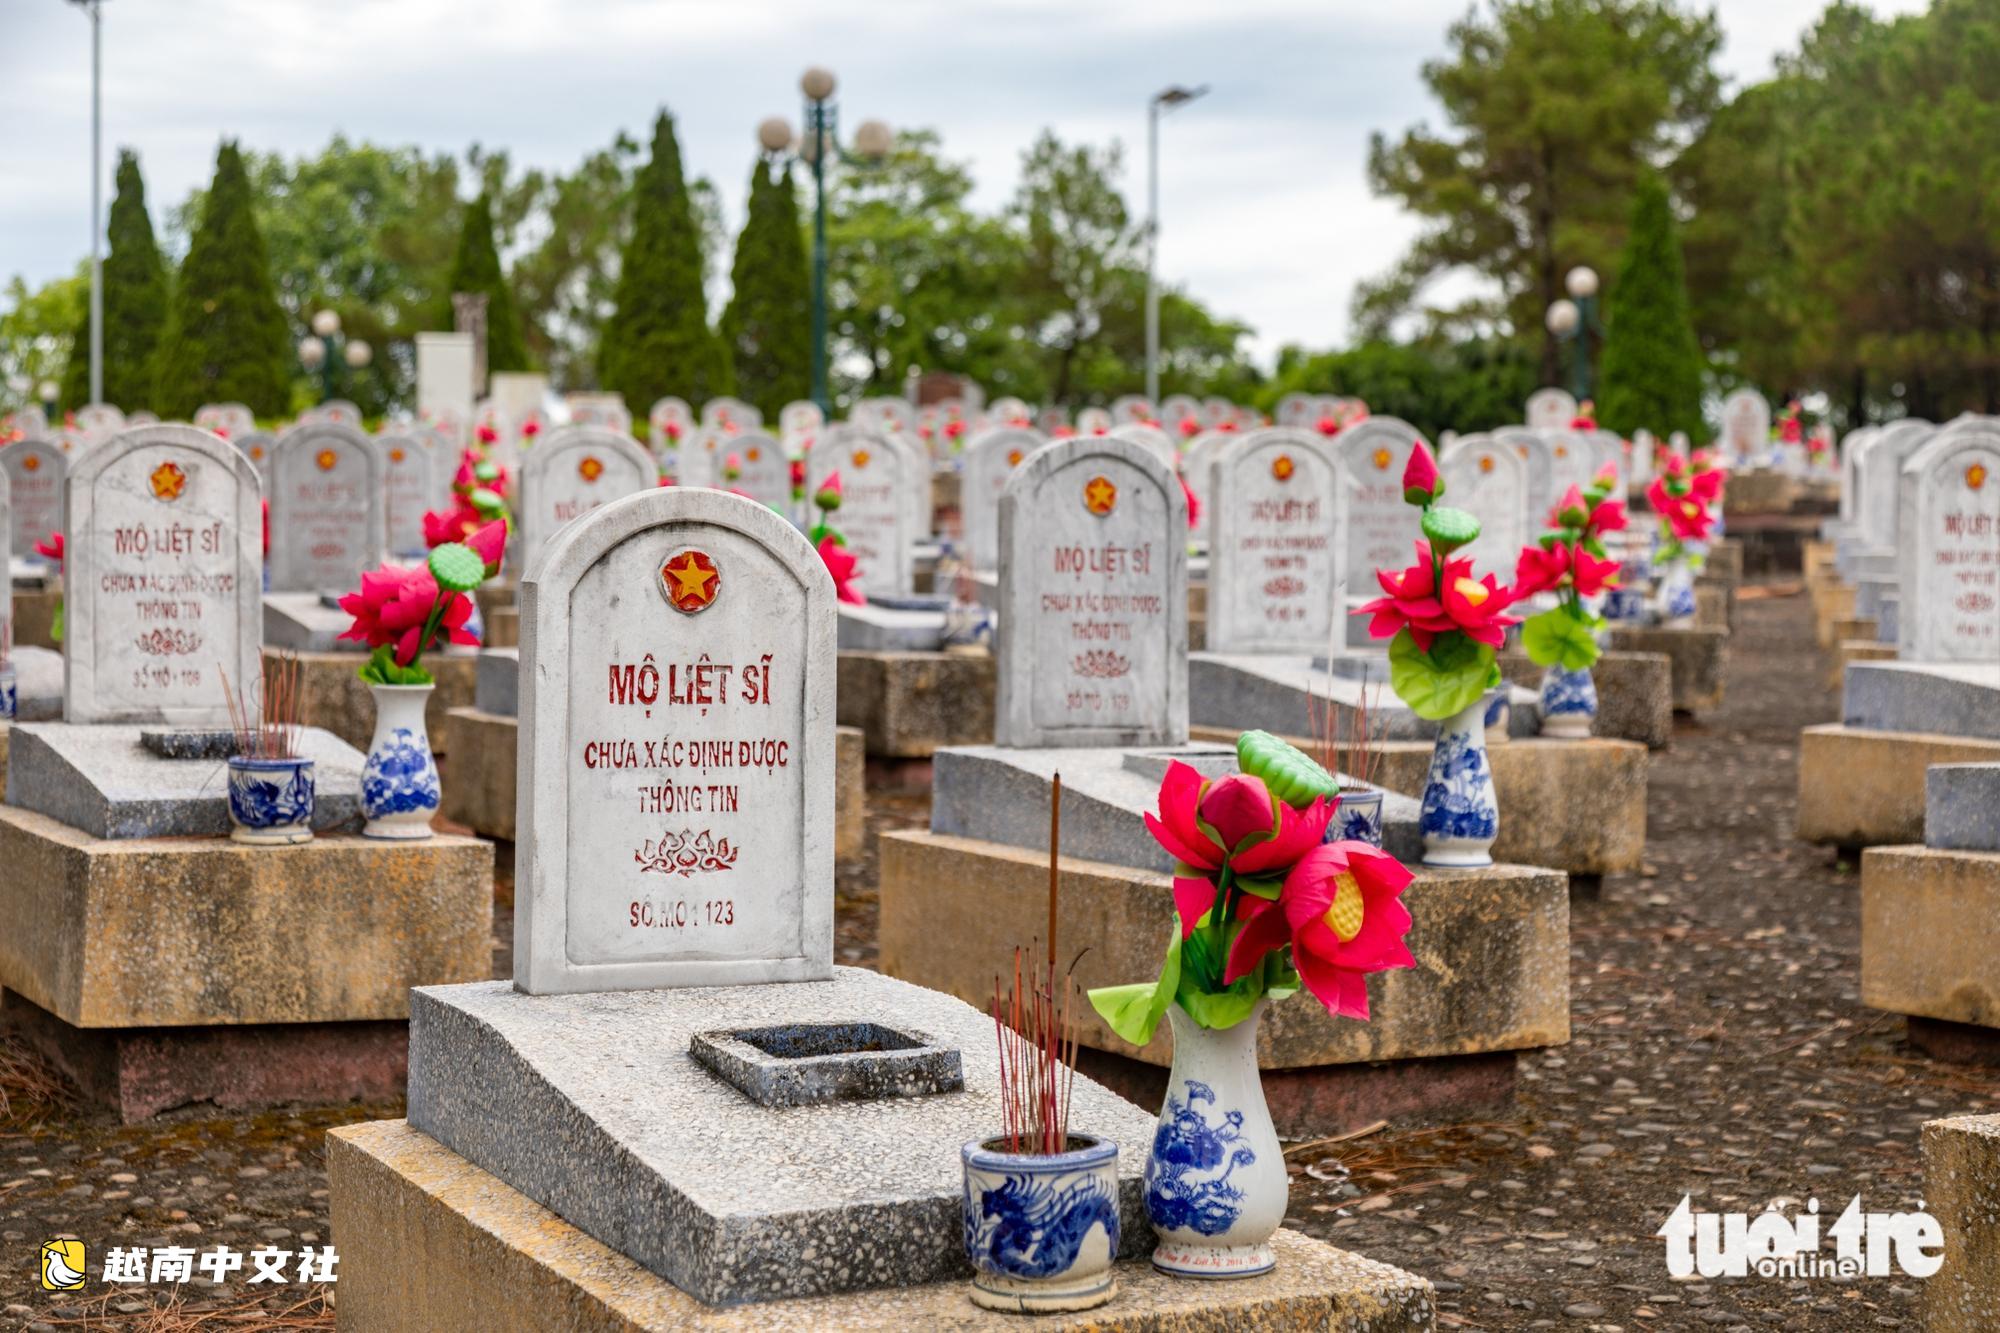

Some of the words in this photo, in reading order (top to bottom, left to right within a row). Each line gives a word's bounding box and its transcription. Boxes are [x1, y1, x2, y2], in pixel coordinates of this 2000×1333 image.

[114, 522, 149, 561] MỘ
[154, 522, 194, 562] LIỆT
[200, 522, 222, 554] SĨ
[608, 653, 660, 718] MỘ
[669, 653, 733, 716] LIỆT
[741, 653, 774, 705] SĨ
[584, 738, 638, 769] CHƯA
[644, 734, 684, 768] XÁC
[688, 740, 734, 775] ĐỊNH
[738, 737, 789, 775] ĐƯỢC
[637, 778, 702, 813] THÔNG
[707, 785, 739, 813] TIN
[705, 900, 735, 926] 123
